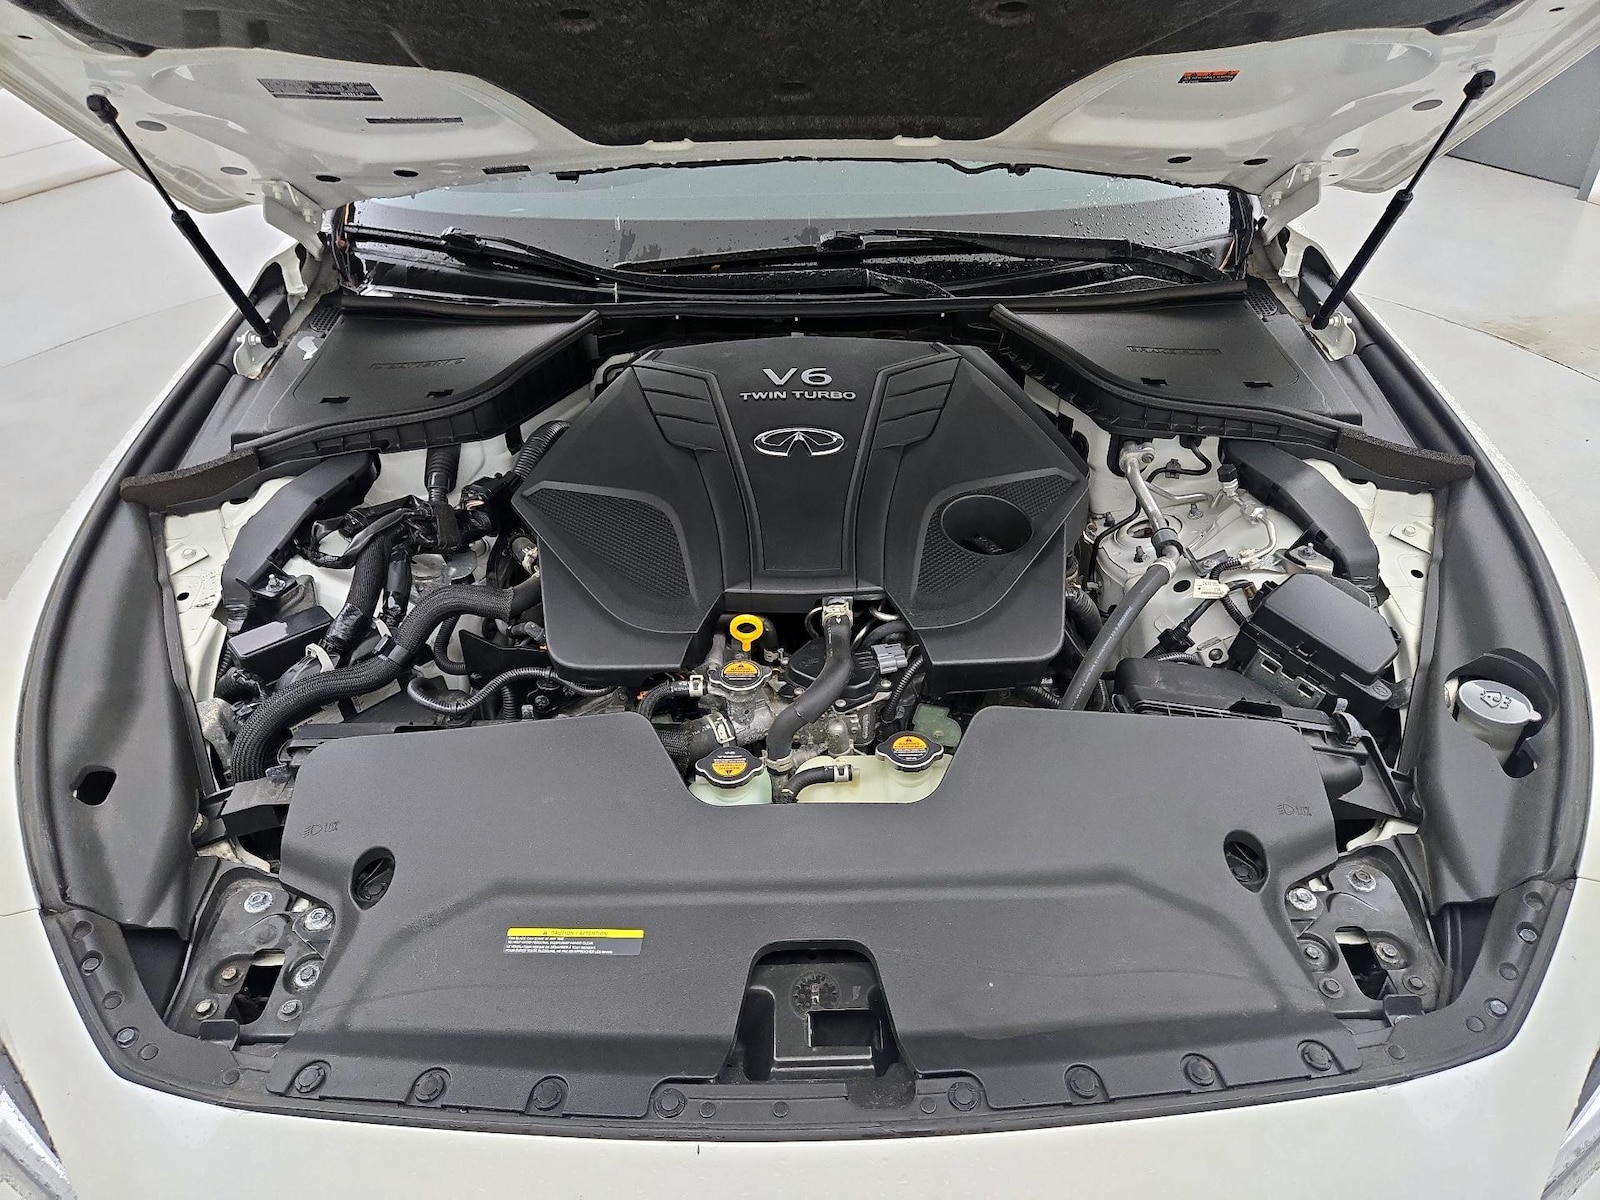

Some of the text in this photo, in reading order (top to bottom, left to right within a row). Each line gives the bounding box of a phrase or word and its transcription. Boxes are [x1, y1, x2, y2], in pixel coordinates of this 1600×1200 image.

[762, 367, 833, 387] V6
[740, 390, 857, 401] TWIN TURBO
